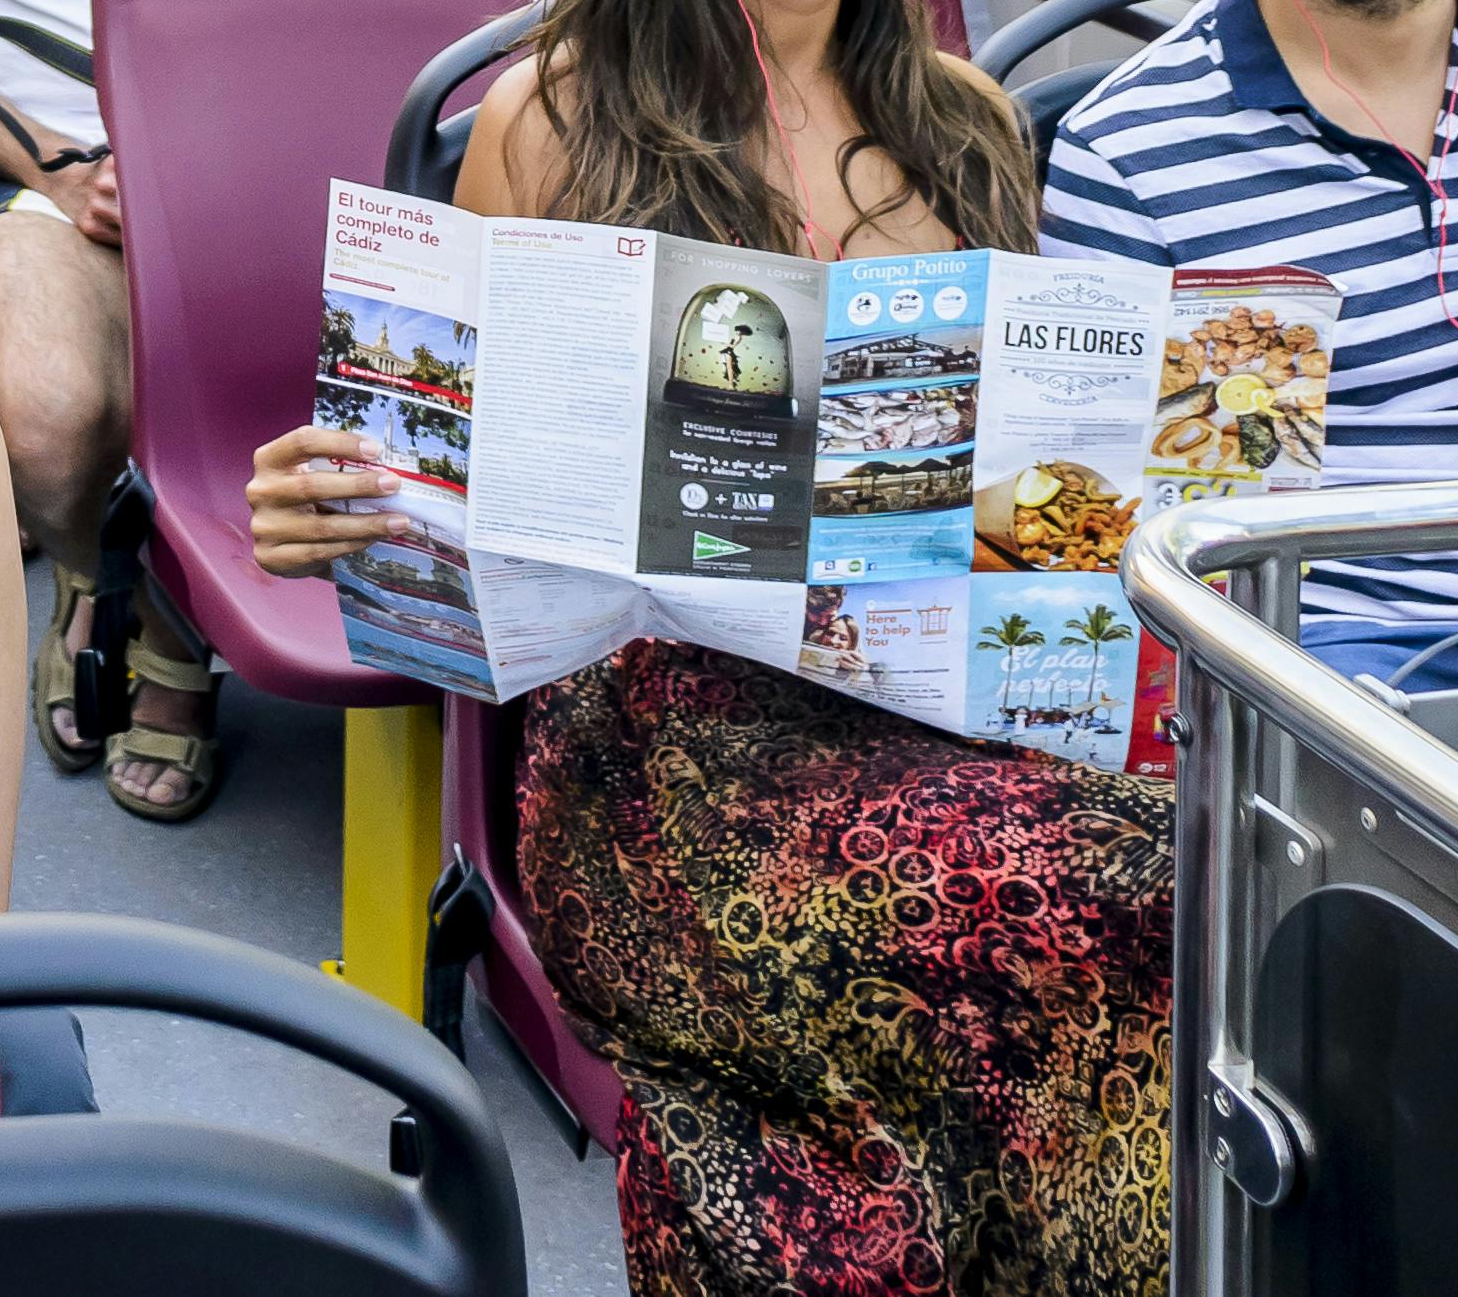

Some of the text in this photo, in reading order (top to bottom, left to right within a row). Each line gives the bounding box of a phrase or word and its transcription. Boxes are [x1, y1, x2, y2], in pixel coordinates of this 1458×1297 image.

[338, 191, 434, 226] El tour más
[335, 230, 383, 253] Cádiz
[336, 214, 440, 247] completo de
[492, 228, 584, 242] Condiciones de Uso
[670, 251, 813, 284] FOR SHOPPING LOVERS
[852, 257, 967, 281] Grupo Potito
[1005, 321, 1145, 356] LAS FLORES
[683, 421, 726, 435] EXCLUSIVE
[865, 624, 912, 637] to help
[866, 614, 897, 625] Here
[865, 637, 889, 647] You
[1000, 646, 1110, 673] El plan
[997, 671, 1112, 698] perfecto
